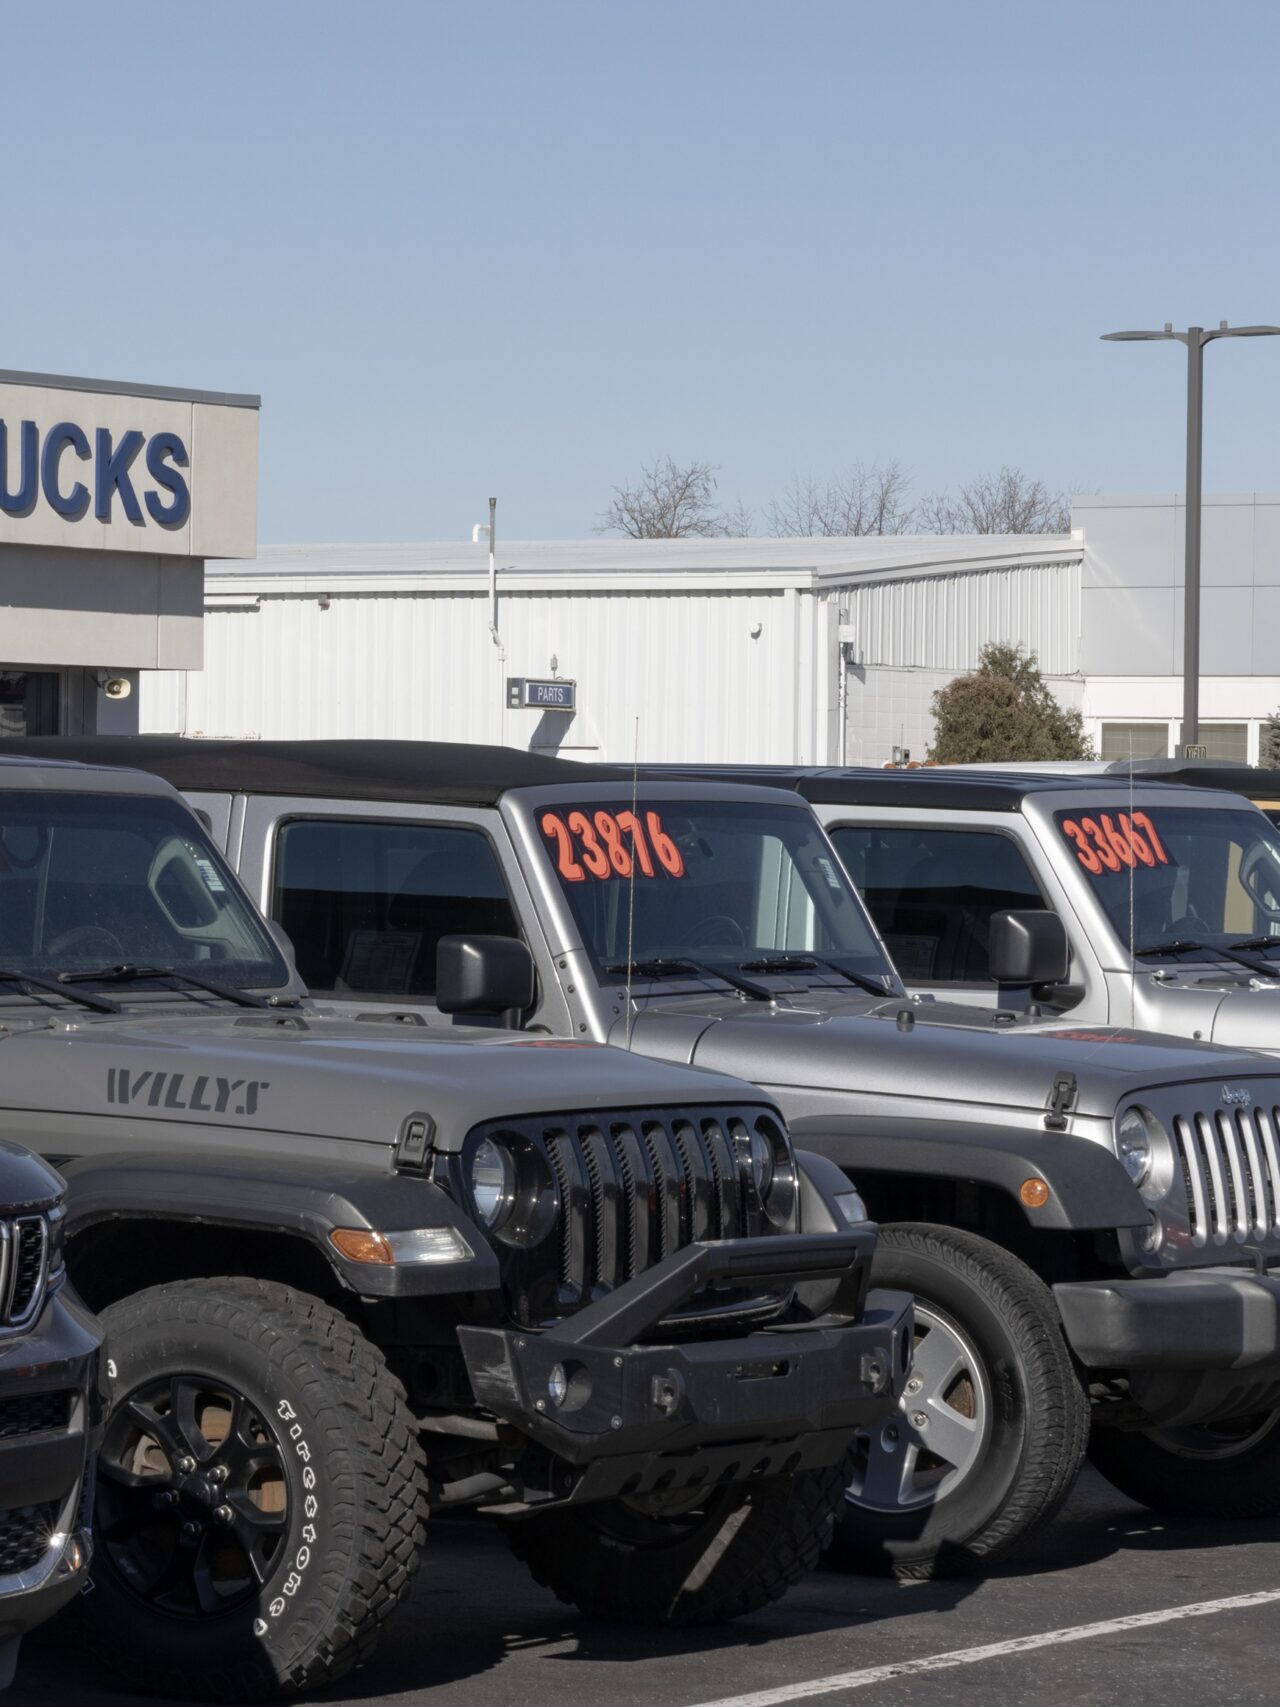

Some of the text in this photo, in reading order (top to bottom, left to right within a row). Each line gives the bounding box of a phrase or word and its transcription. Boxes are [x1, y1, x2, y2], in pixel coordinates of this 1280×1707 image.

[537, 687, 564, 703] PARTS
[541, 810, 685, 882] 23876
[1062, 811, 1169, 875] 33667
[107, 1067, 271, 1116] WILLYS
[1219, 1084, 1252, 1108] Jeep
[269, 1399, 318, 1618] Firestone
